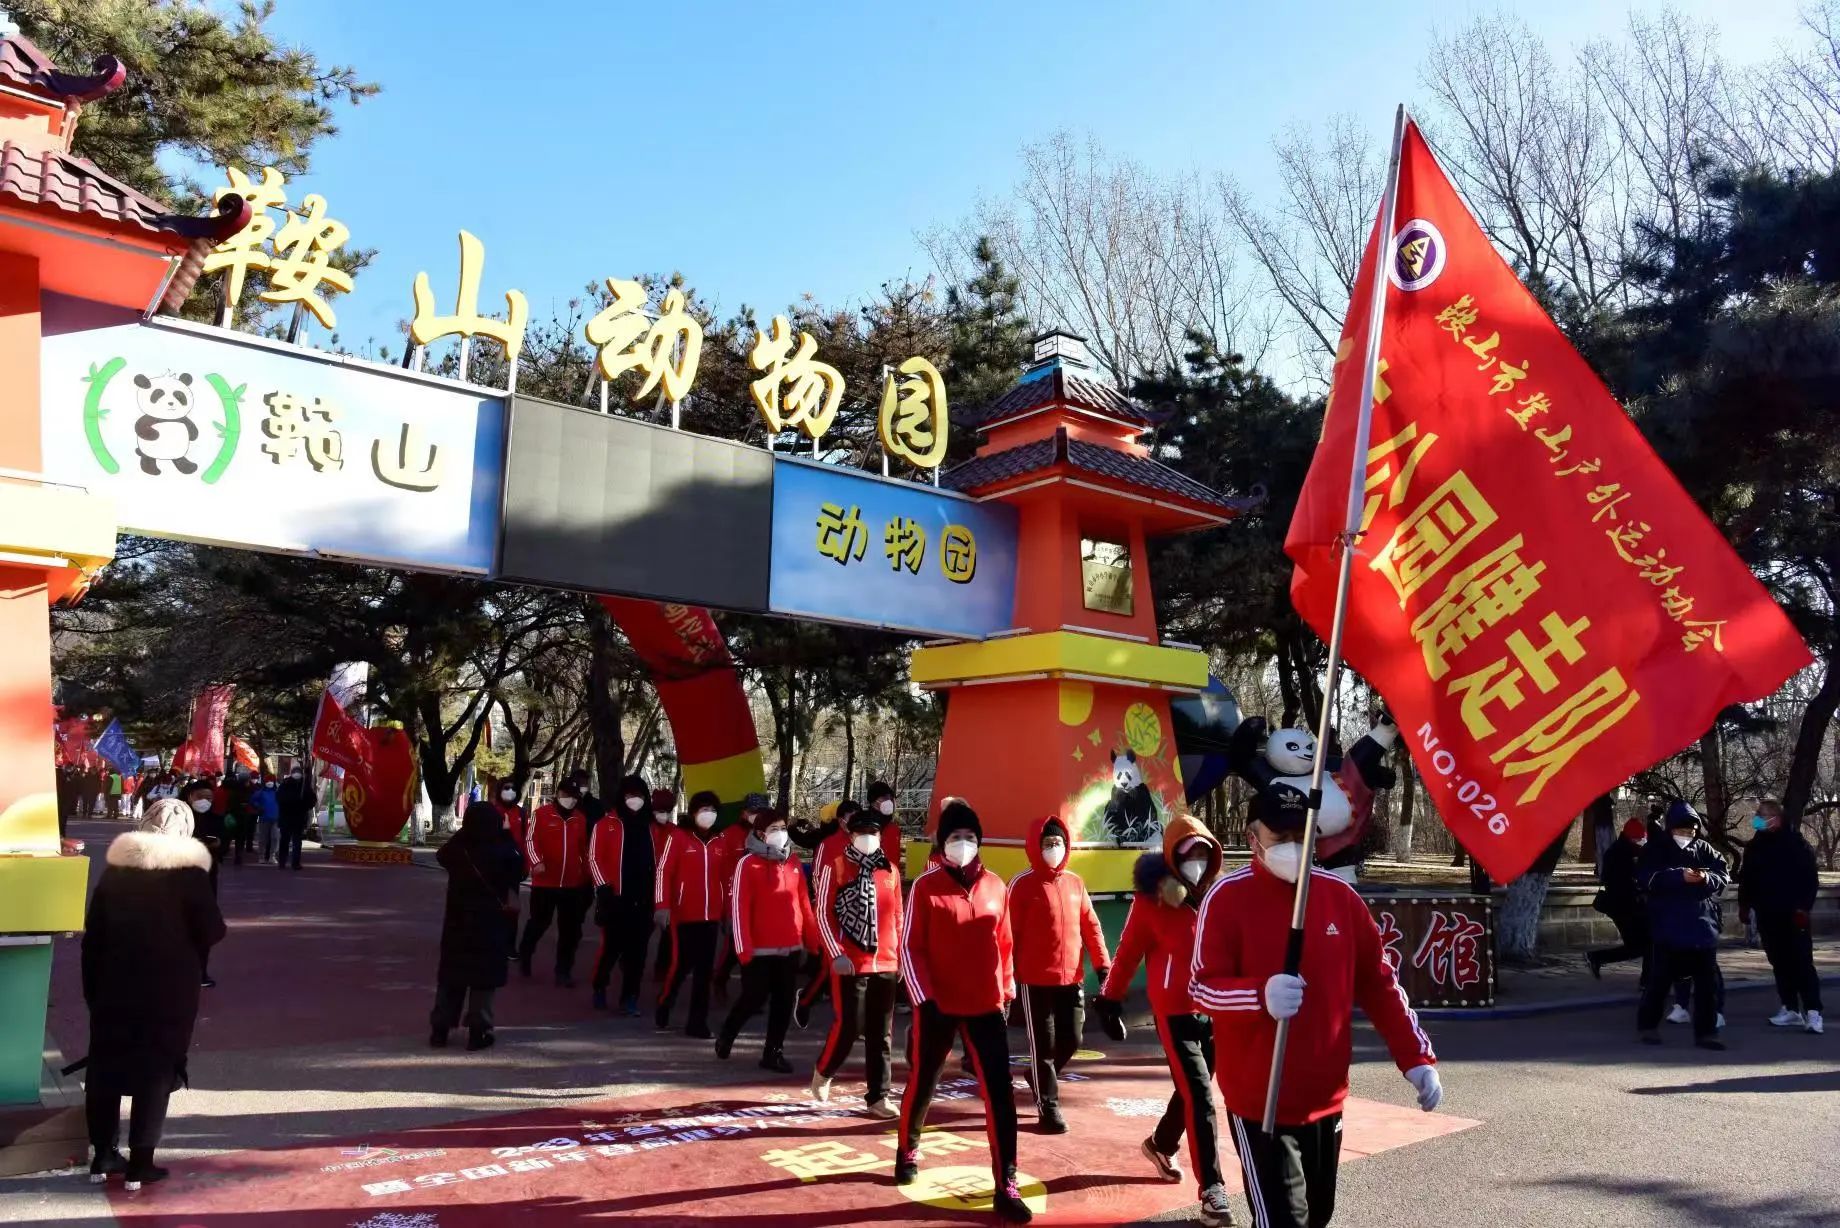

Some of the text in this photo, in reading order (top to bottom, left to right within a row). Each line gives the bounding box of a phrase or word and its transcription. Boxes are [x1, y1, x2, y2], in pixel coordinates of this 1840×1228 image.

[202, 166, 948, 468] 鞍山动物园
[260, 391, 976, 584] 鞍山 动物园
[1354, 358, 1641, 806] 公园健走队
[1434, 294, 1728, 653] 鞍山市登山户外运动协会
[1416, 721, 1510, 835] NO:026
